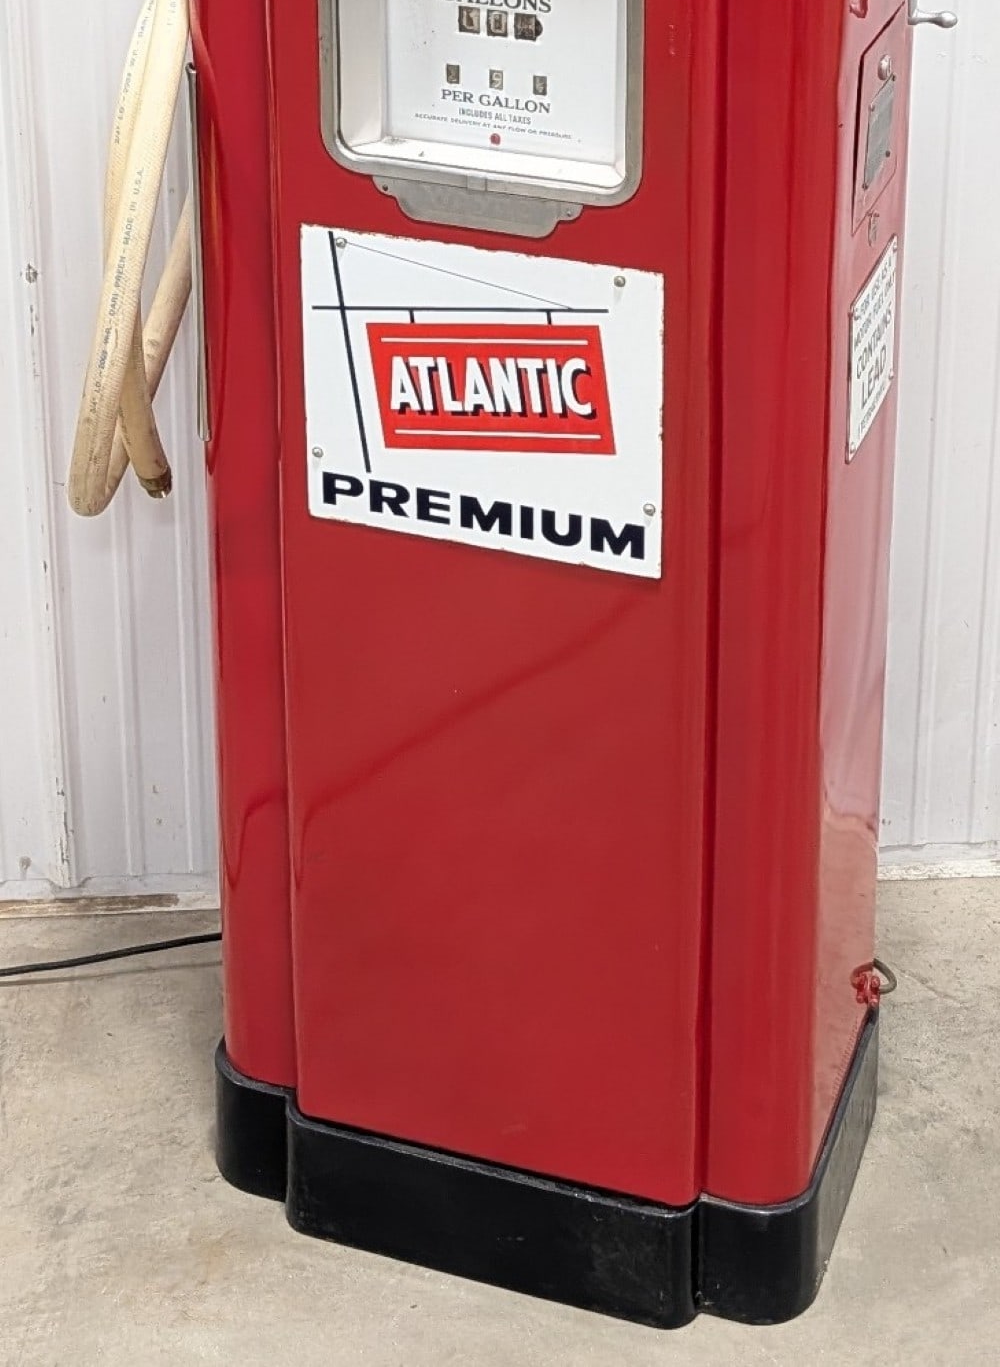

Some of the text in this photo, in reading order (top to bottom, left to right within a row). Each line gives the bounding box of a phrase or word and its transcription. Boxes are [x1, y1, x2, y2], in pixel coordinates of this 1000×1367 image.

[441, 89, 551, 114] PER GALLON
[459, 107, 531, 125] INCLUDES ALL TAXES
[122, 217, 134, 245] MADE
[129, 201, 138, 211] IN
[857, 301, 891, 380] CONTAINS
[390, 355, 595, 418] ATLANTIC
[862, 344, 886, 410] LEAD
[322, 471, 645, 560] PREMIUM
